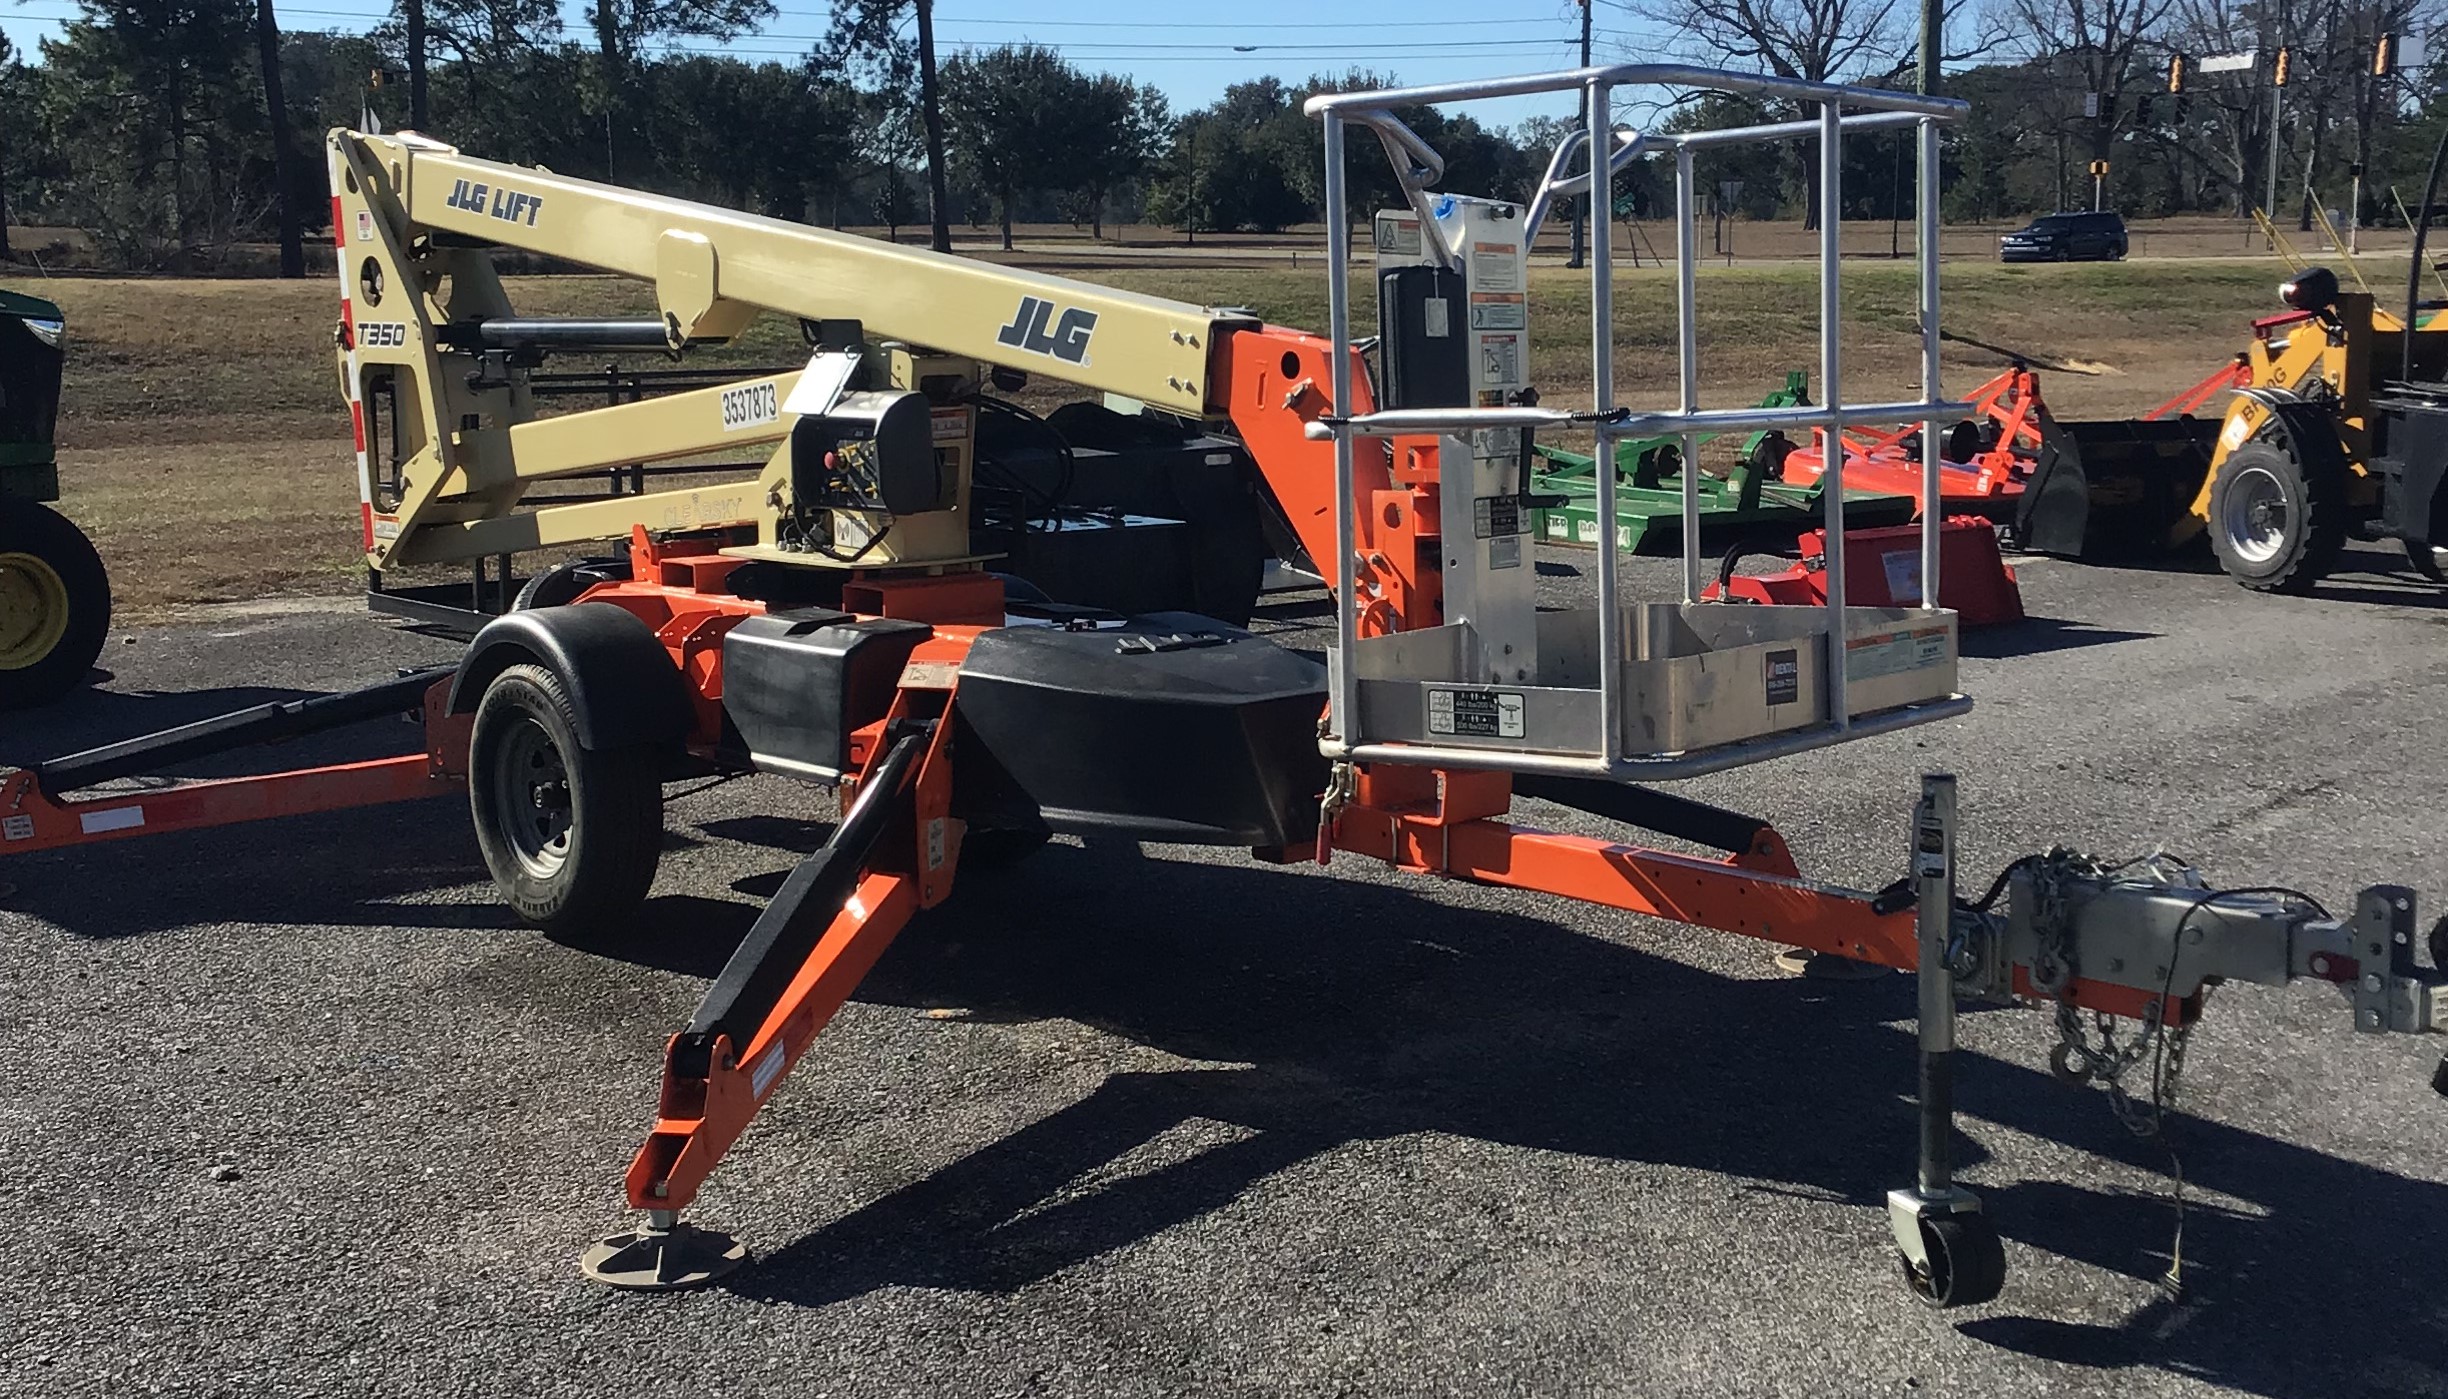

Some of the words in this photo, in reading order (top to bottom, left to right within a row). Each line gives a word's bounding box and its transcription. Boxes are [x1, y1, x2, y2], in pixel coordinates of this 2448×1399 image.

[446, 178, 489, 214] JLG
[491, 188, 543, 226] LIFT
[358, 323, 406, 346] T350
[997, 296, 1098, 364] JLG
[722, 383, 776, 425] 3537873
